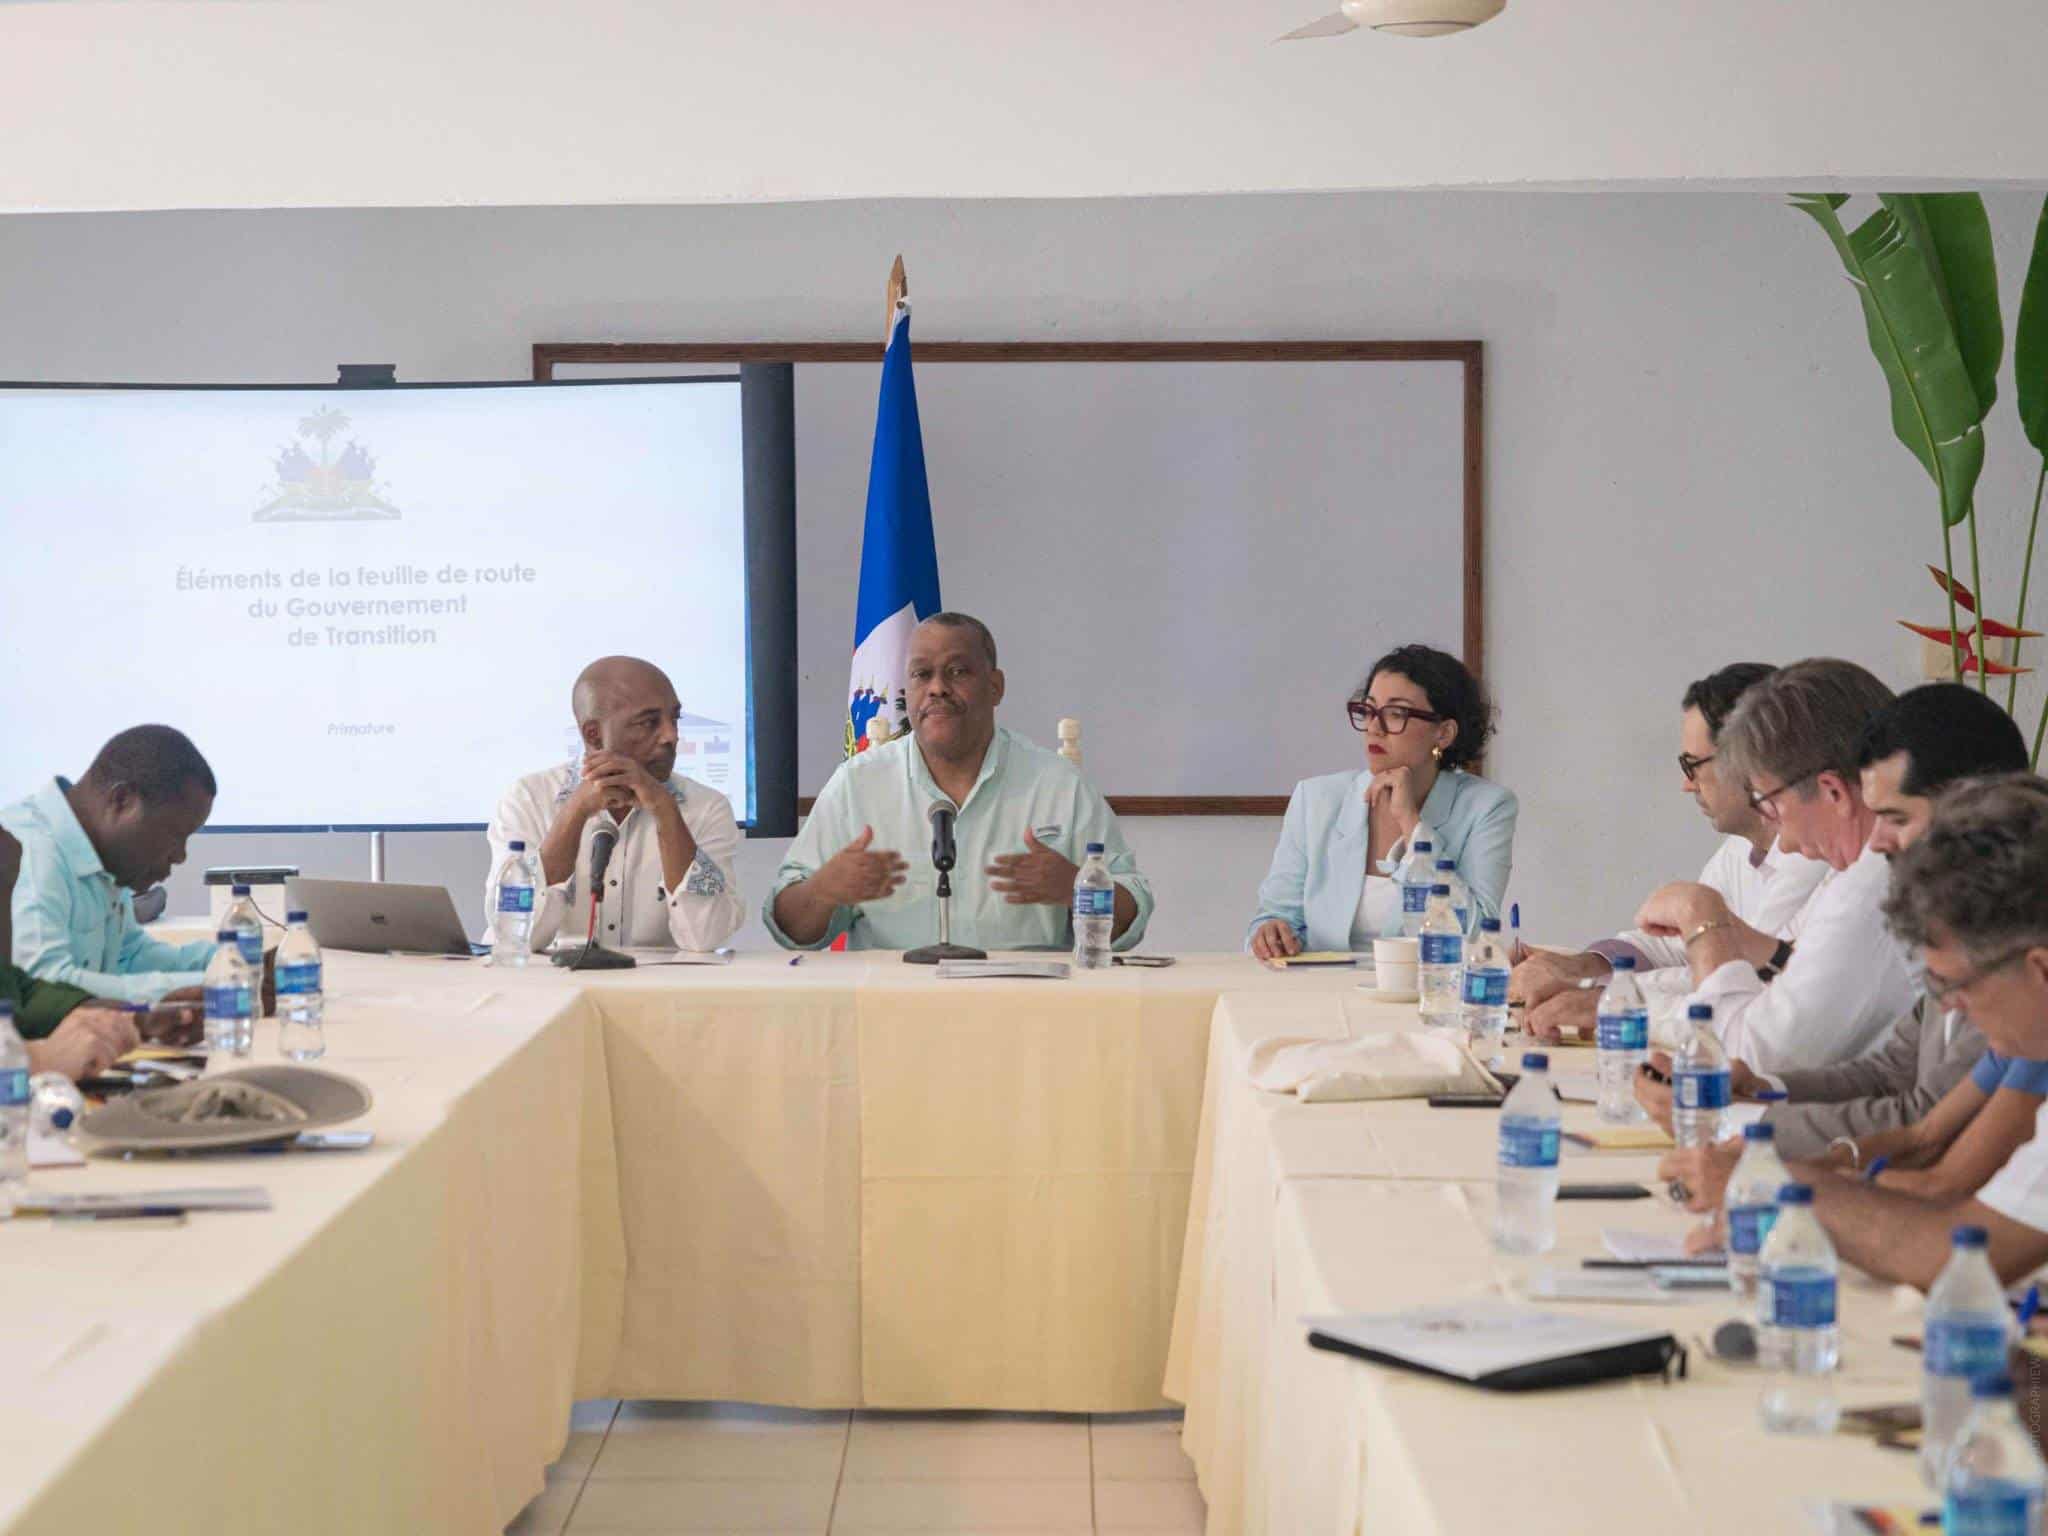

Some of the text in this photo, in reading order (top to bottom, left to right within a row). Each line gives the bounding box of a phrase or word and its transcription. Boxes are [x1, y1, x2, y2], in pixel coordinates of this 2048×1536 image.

[176, 561, 537, 592] Éléments de la feuille de route
[247, 594, 468, 619] du Gouvernement
[288, 624, 438, 647] de Transition
[327, 722, 396, 737] Primature
